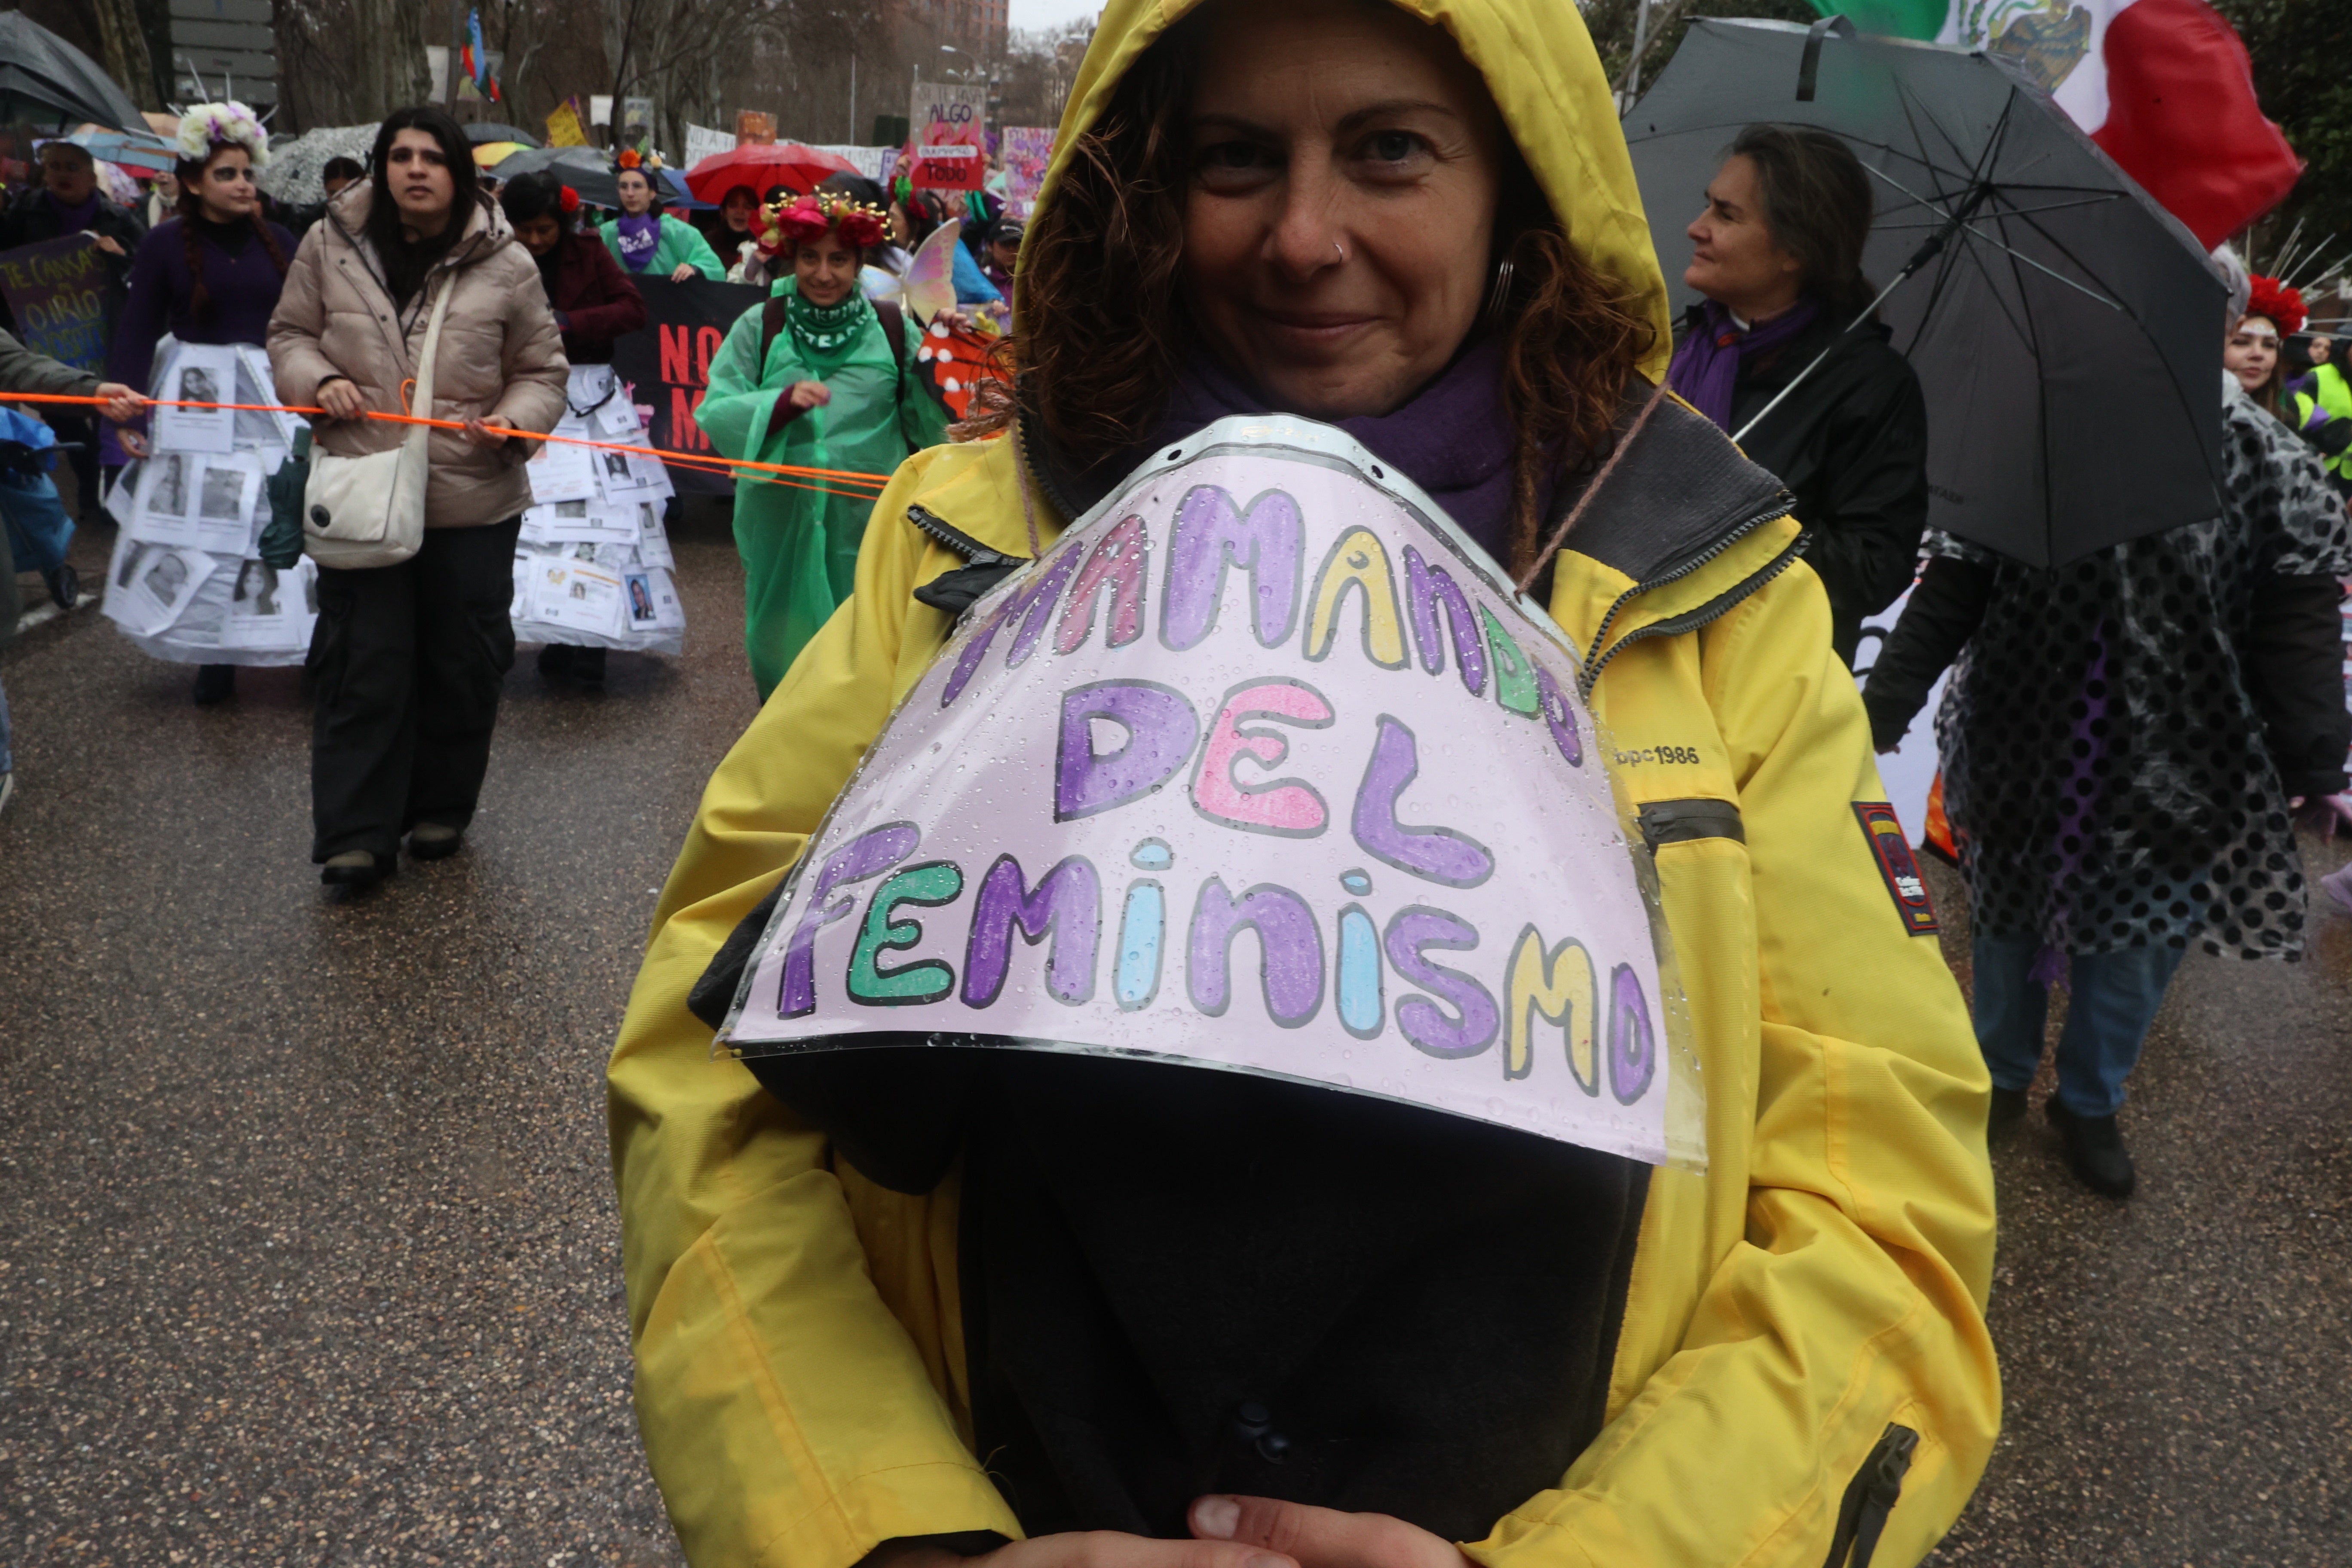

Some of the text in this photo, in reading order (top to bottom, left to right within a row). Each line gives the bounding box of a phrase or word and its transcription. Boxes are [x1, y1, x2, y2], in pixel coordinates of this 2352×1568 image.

[930, 104, 972, 122] ALGO
[925, 163, 967, 182] TODO
[1055, 677, 1494, 888] DEL
